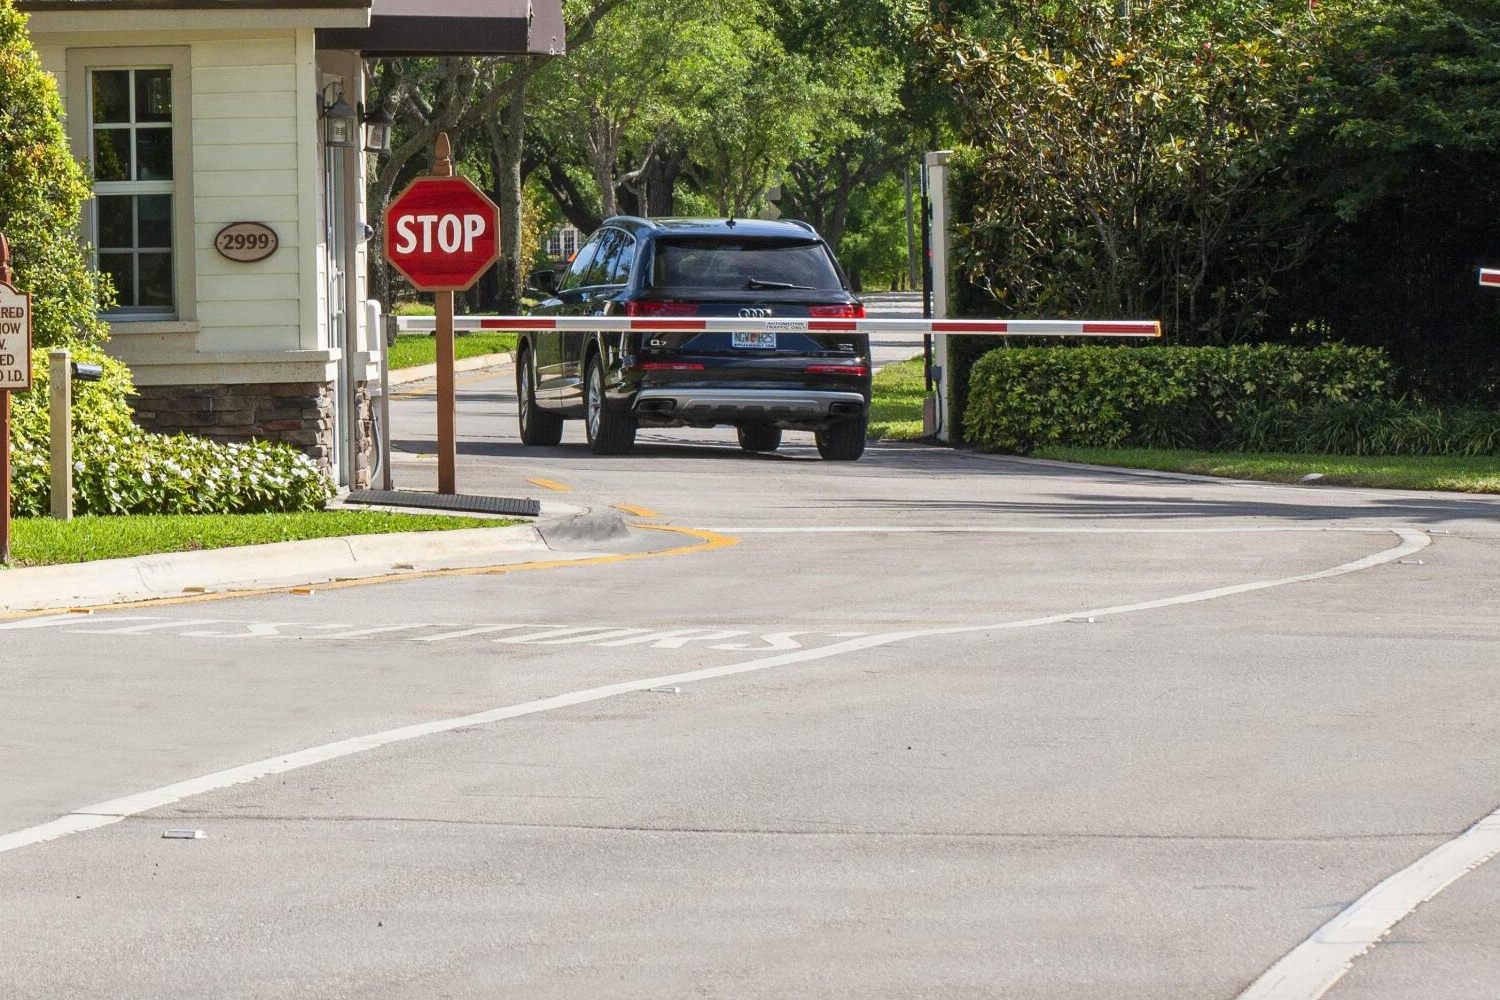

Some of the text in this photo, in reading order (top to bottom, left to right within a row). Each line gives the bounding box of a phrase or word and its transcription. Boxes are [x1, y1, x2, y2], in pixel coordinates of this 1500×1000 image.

[222, 233, 270, 251] 2999
[396, 213, 486, 254] STOP
[8, 370, 25, 382] I.D.
